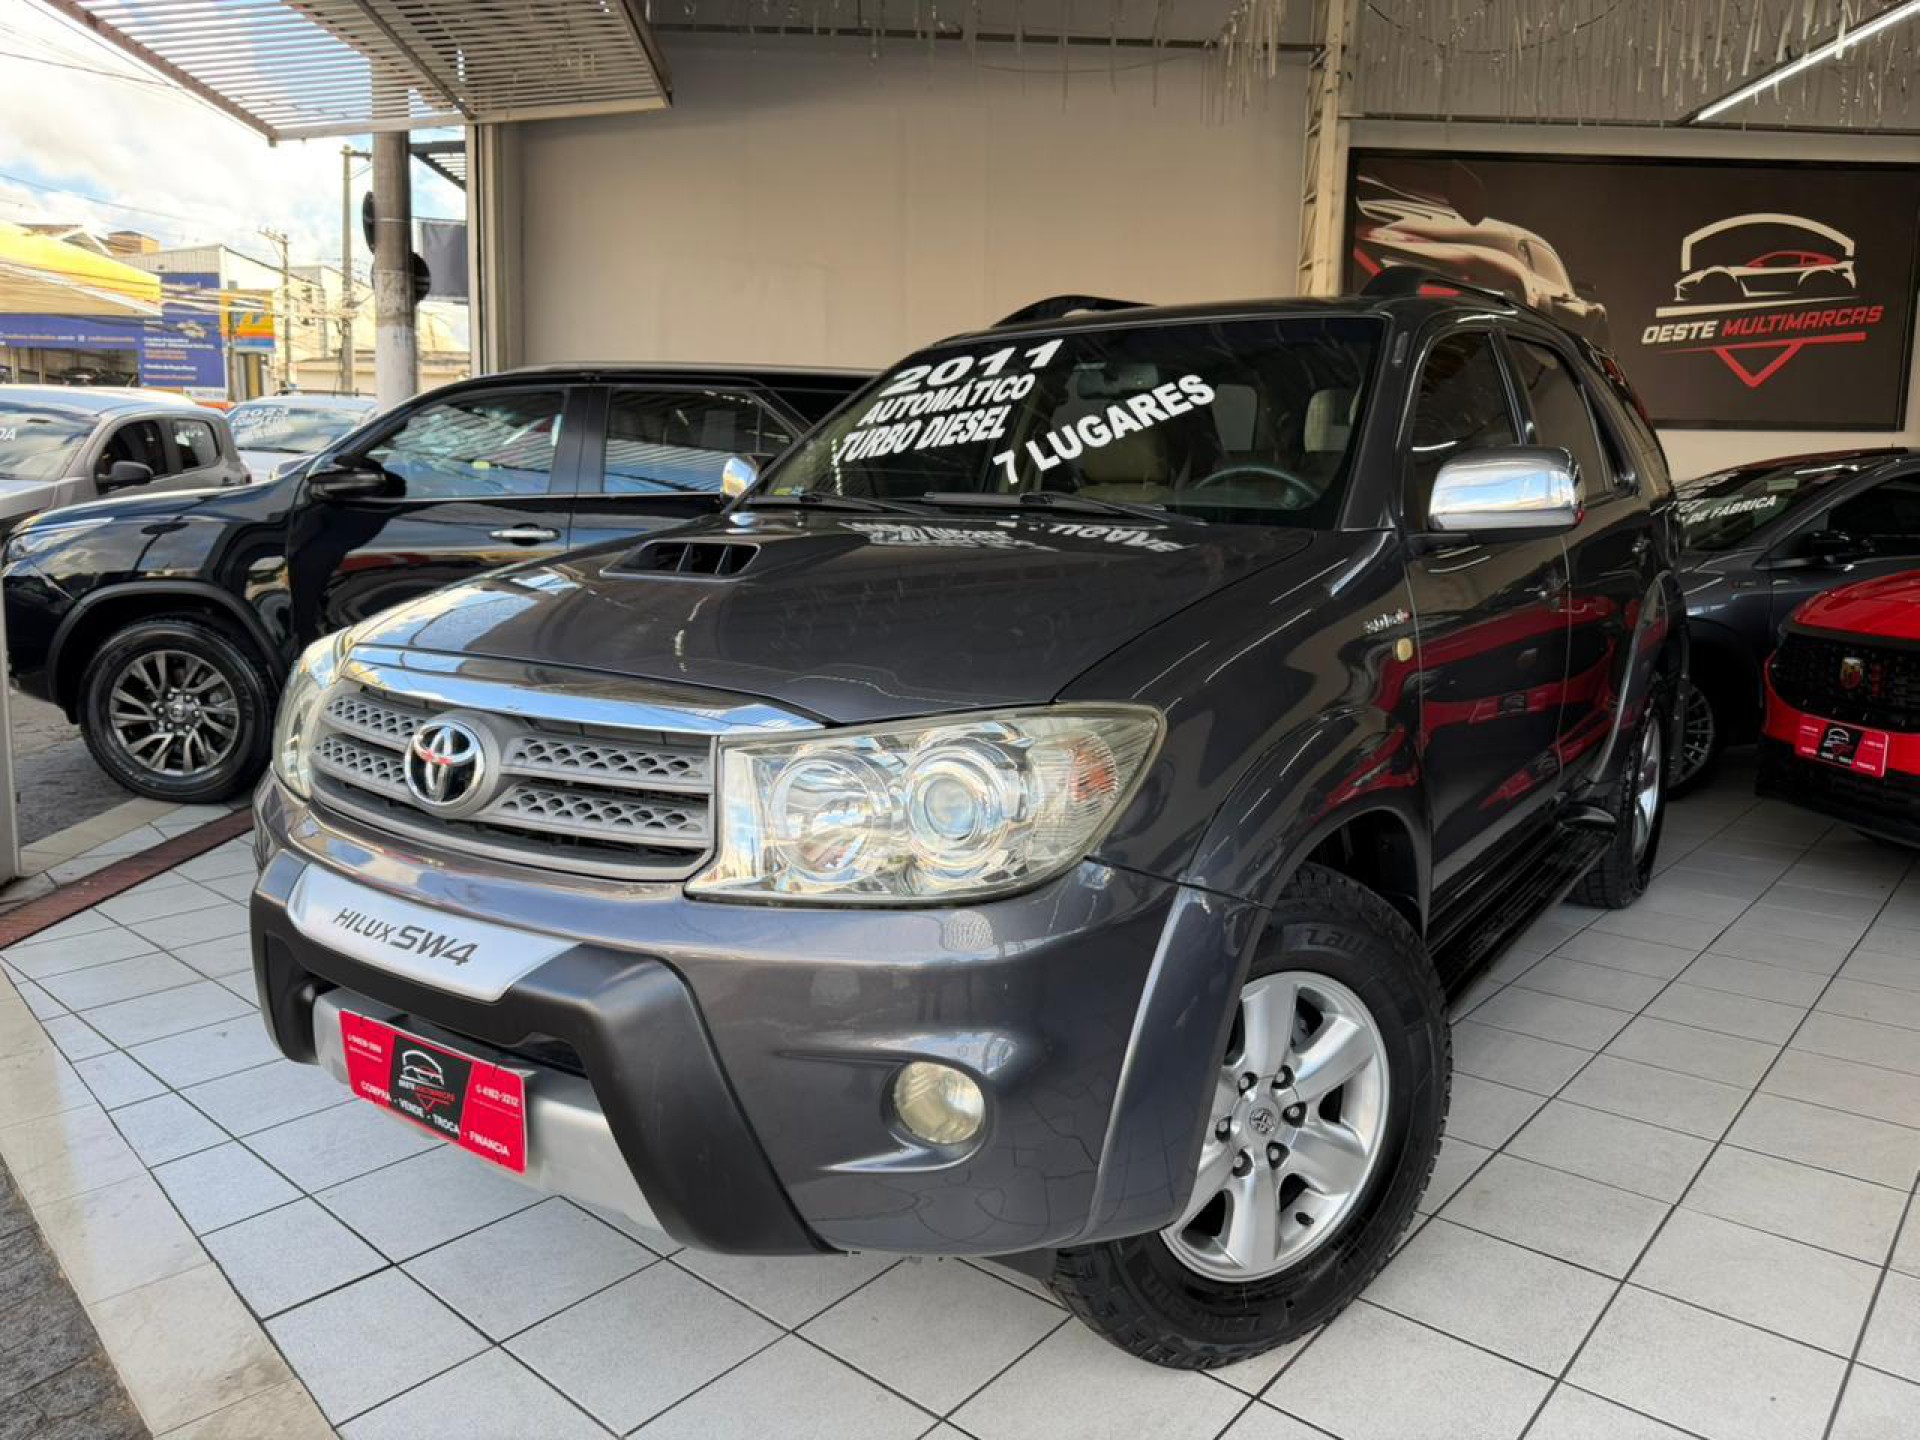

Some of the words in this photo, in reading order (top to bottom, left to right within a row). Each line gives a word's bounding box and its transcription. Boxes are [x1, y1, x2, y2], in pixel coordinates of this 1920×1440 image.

[1641, 320, 1719, 345] OESTE
[1721, 305, 1884, 337] MULTIMARCAS
[878, 338, 1064, 397] 2011
[856, 373, 1036, 427] AUTOMÁTICO
[838, 419, 922, 462] TURBO
[914, 404, 1012, 450] DIESEL
[992, 450, 1019, 485] 7
[1025, 374, 1216, 472] LUGARES
[332, 907, 398, 943] HILUX
[390, 924, 479, 966] SW4
[432, 1112, 461, 1134] TROCA
[468, 1130, 511, 1157] FINANCIA
